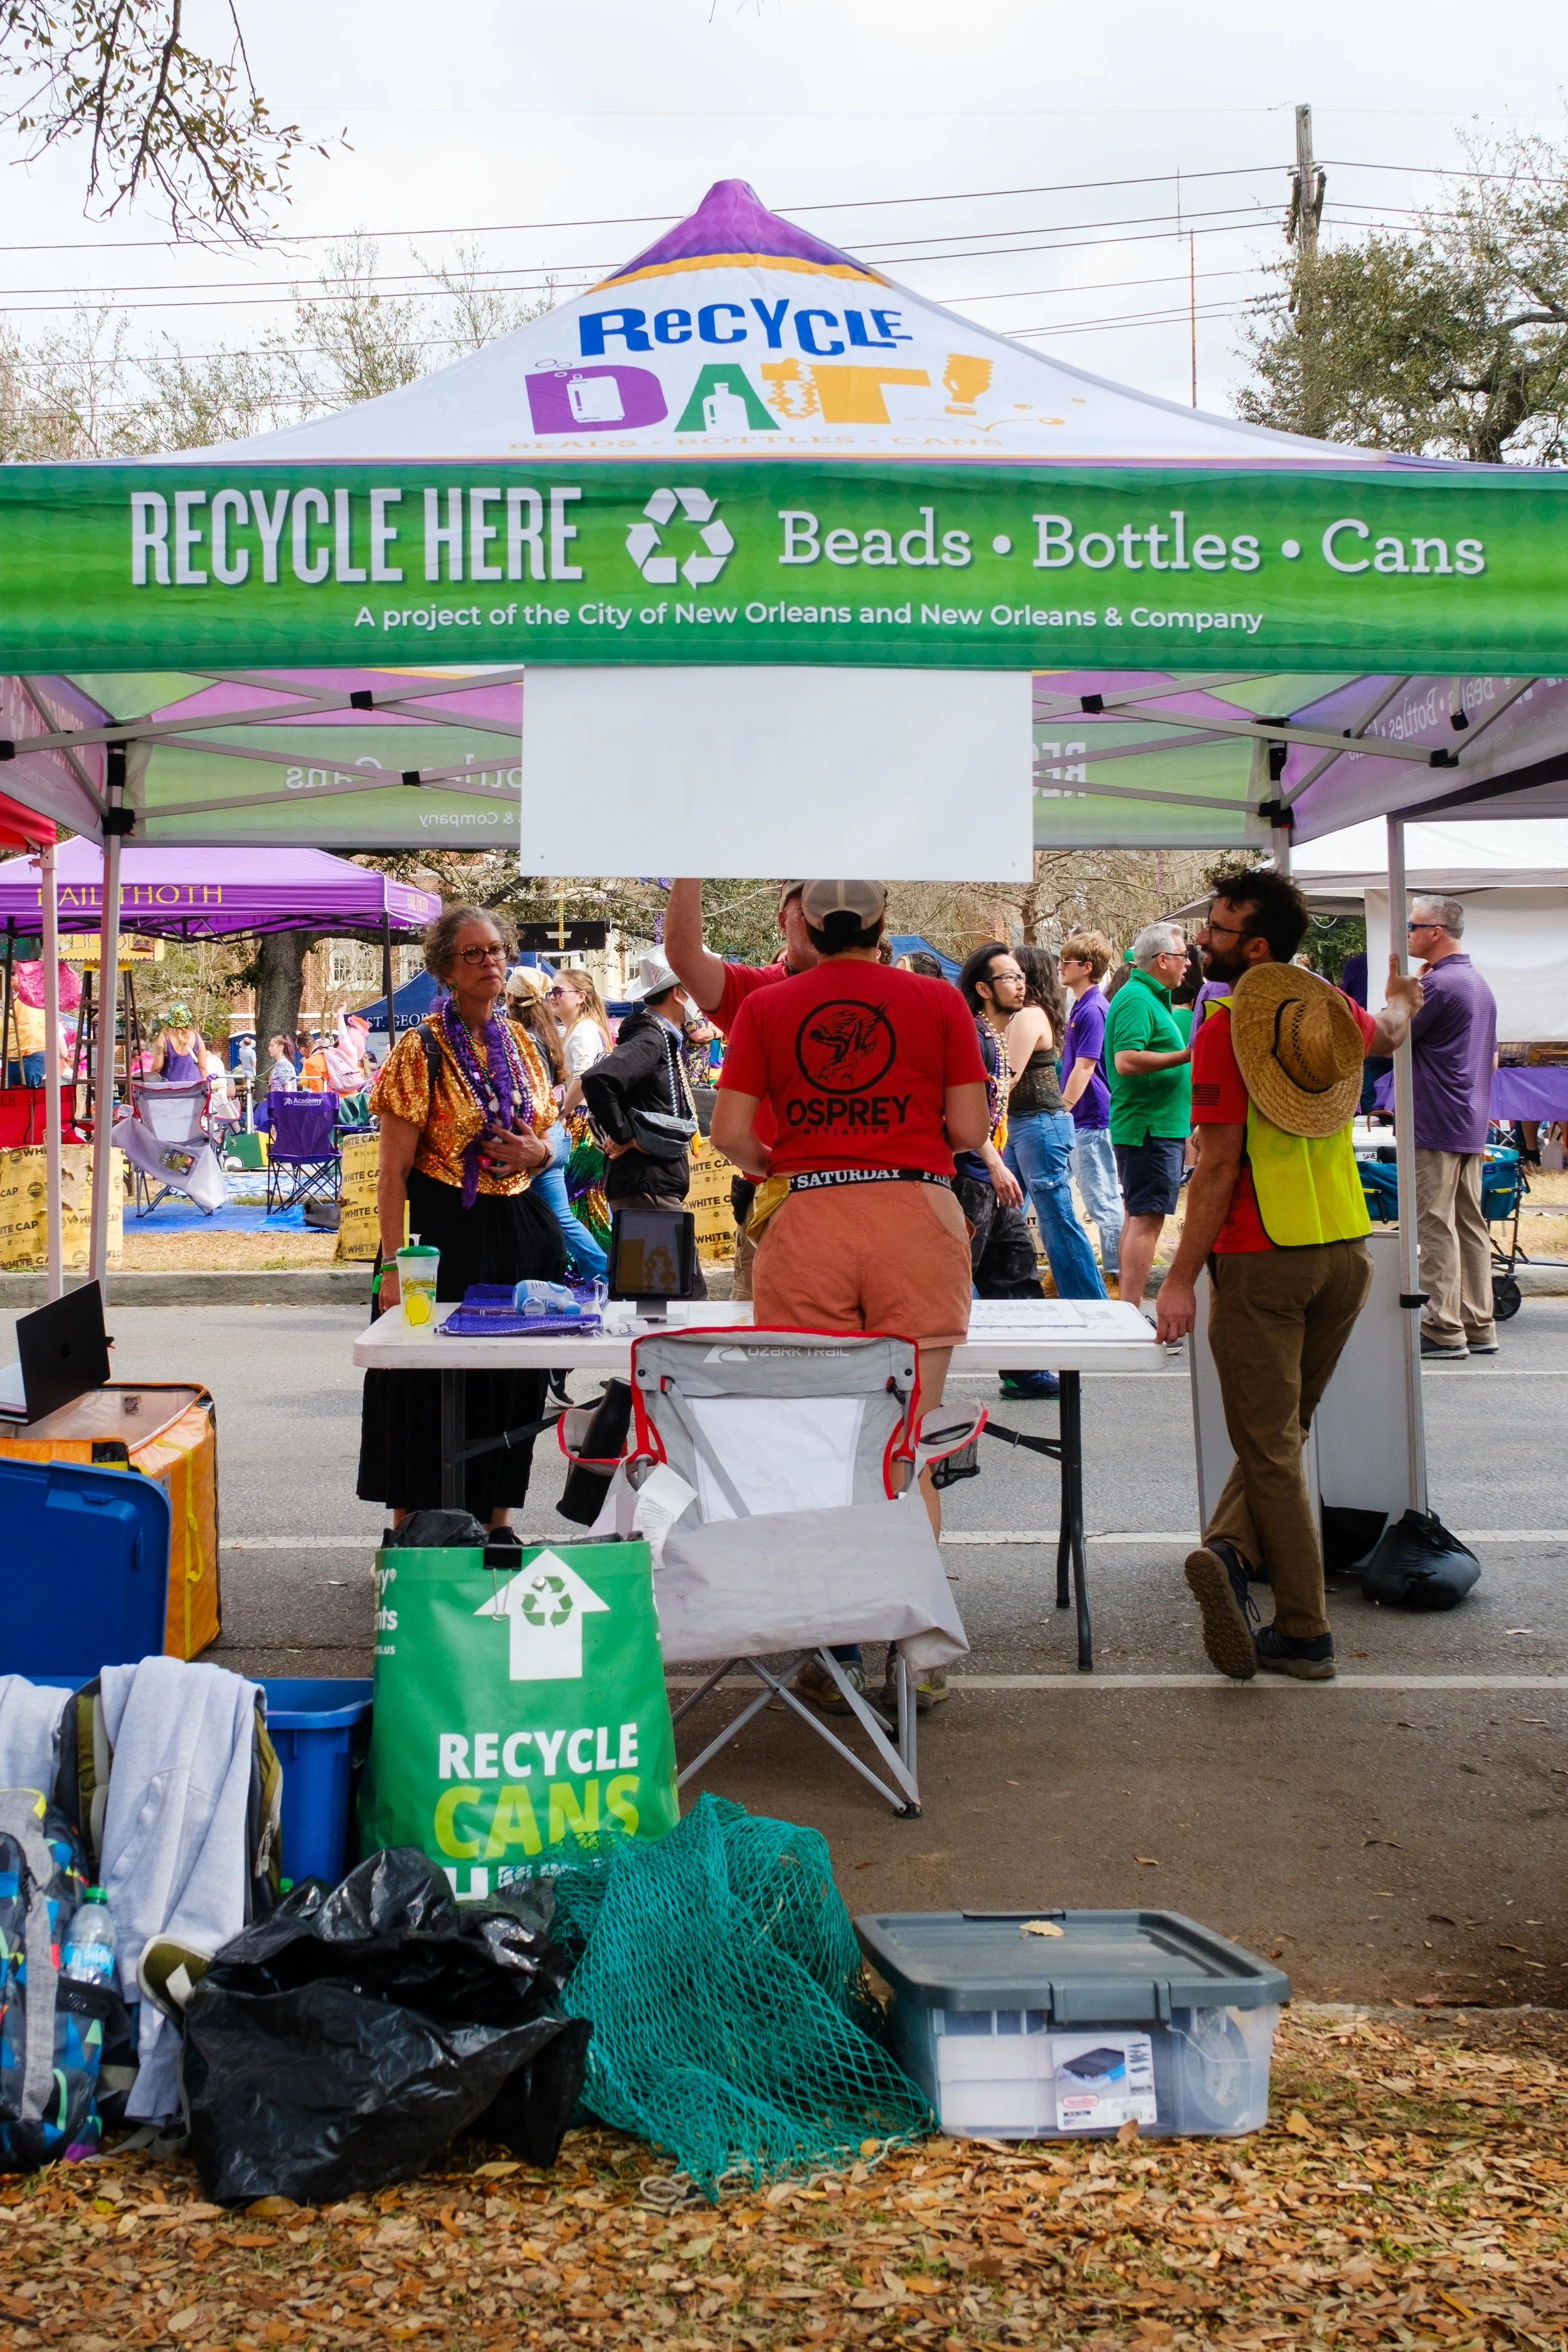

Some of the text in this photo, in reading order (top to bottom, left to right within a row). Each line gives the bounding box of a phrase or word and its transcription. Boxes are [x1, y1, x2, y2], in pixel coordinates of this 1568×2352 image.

[508, 436, 1003, 450] BEADS BOTTLES CANS
[130, 487, 583, 586] RECYCLE HERE
[778, 507, 1486, 576] Beads Bottles Cans
[354, 601, 1264, 635] A project of the City of New Orleans and New Orleans & Company
[293, 1098, 324, 1106] Academy
[787, 1094, 912, 1126] OSPREY
[798, 1125, 890, 1136] INITIATIVE
[797, 1169, 901, 1189] SATURDAY
[689, 1196, 721, 1209] WHITE
[344, 1207, 371, 1219] WHITE
[16, 1220, 39, 1232] CAP
[695, 1231, 731, 1244] WHITE
[347, 1242, 378, 1254] WHITE
[439, 1722, 639, 1780] RECYCLE
[433, 1774, 641, 1860] CANS
